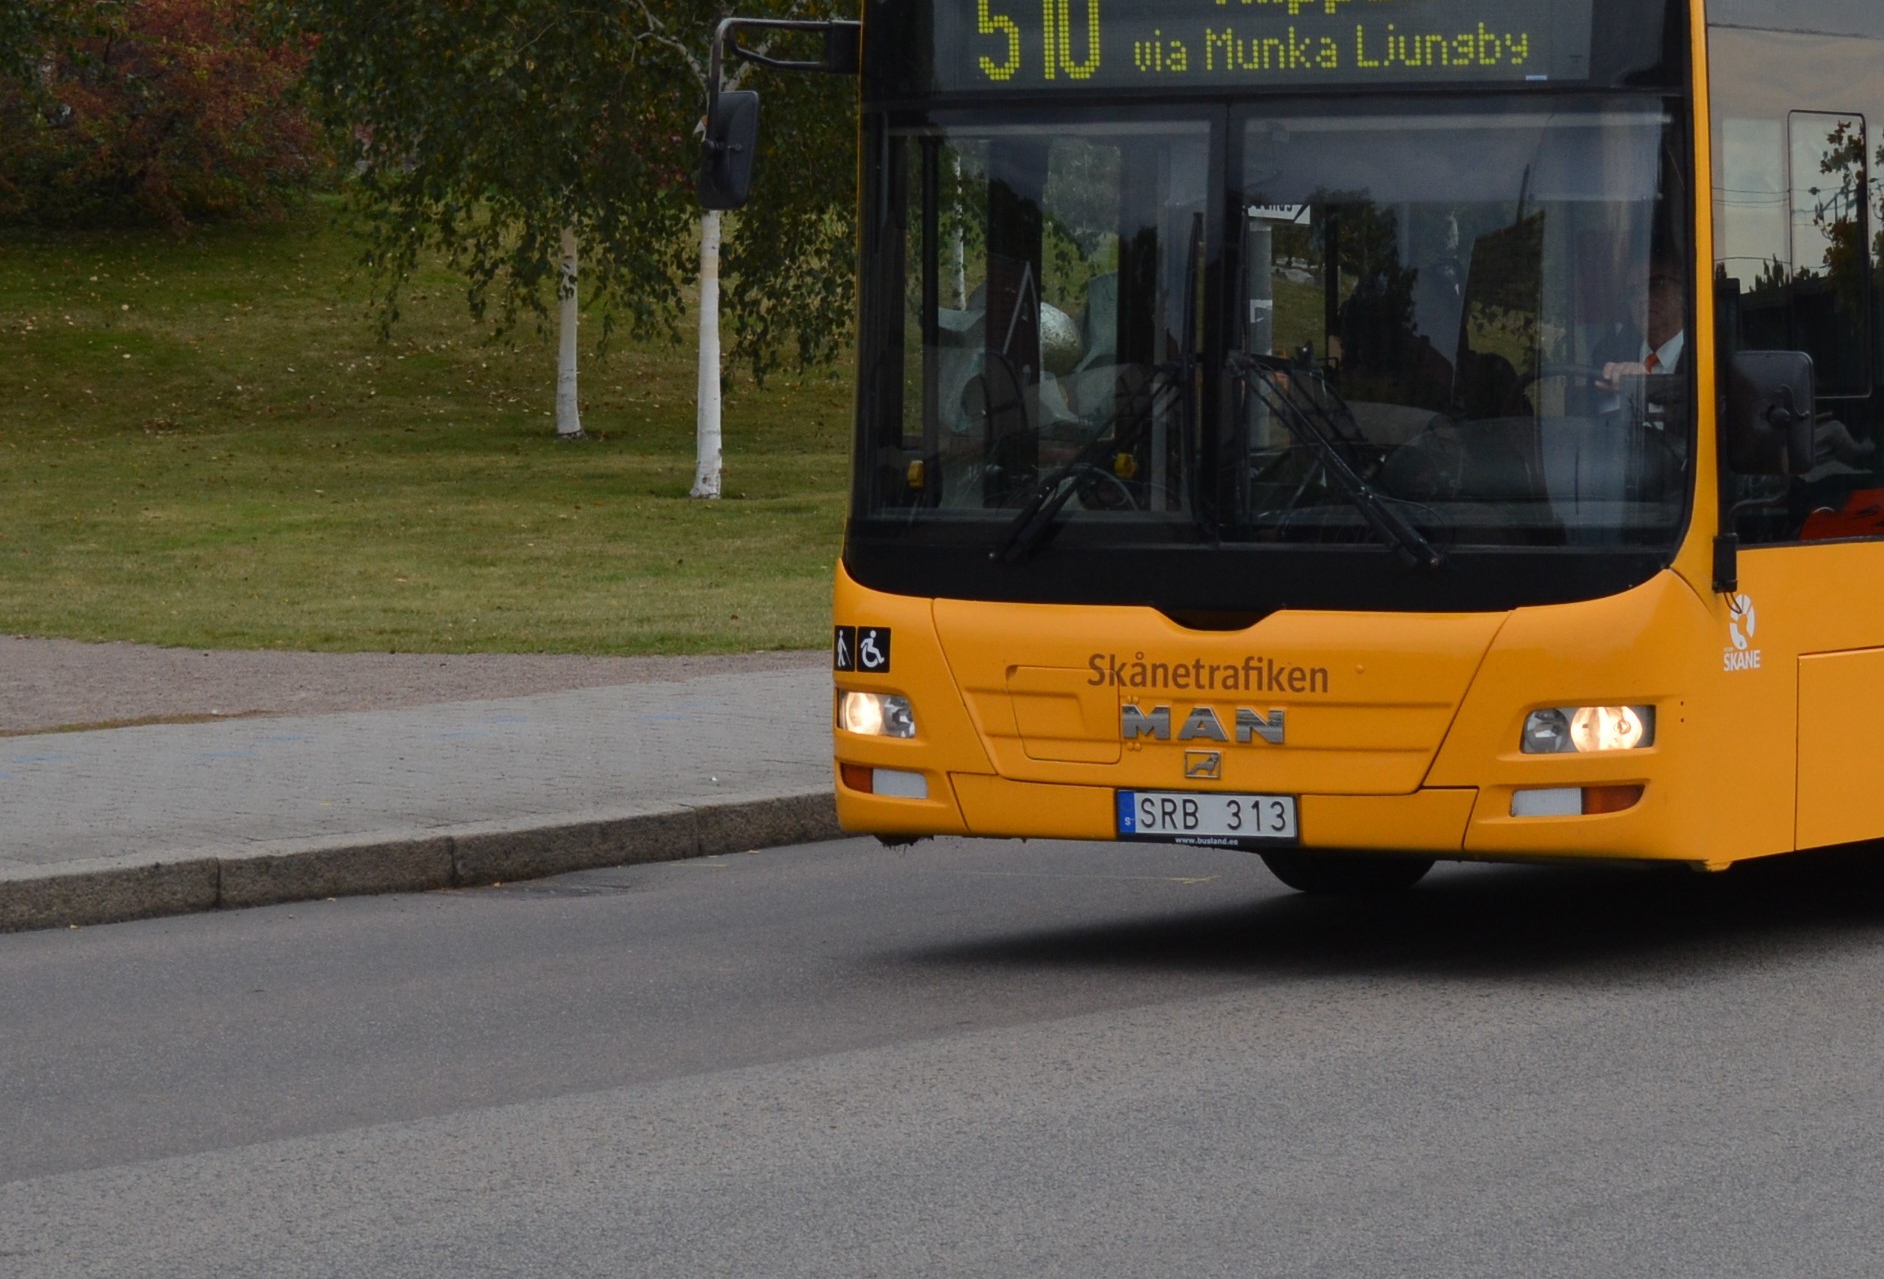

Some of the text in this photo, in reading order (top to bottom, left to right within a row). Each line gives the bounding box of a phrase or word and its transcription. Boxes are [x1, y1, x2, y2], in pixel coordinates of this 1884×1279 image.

[1134, 21, 1528, 71] via Munka Ljungby
[1087, 651, 1329, 694] Skånetrafiken
[1121, 703, 1286, 744] MAN
[1140, 798, 1287, 832] SRB 313
[1175, 837, 1239, 846] www.busland.ee
